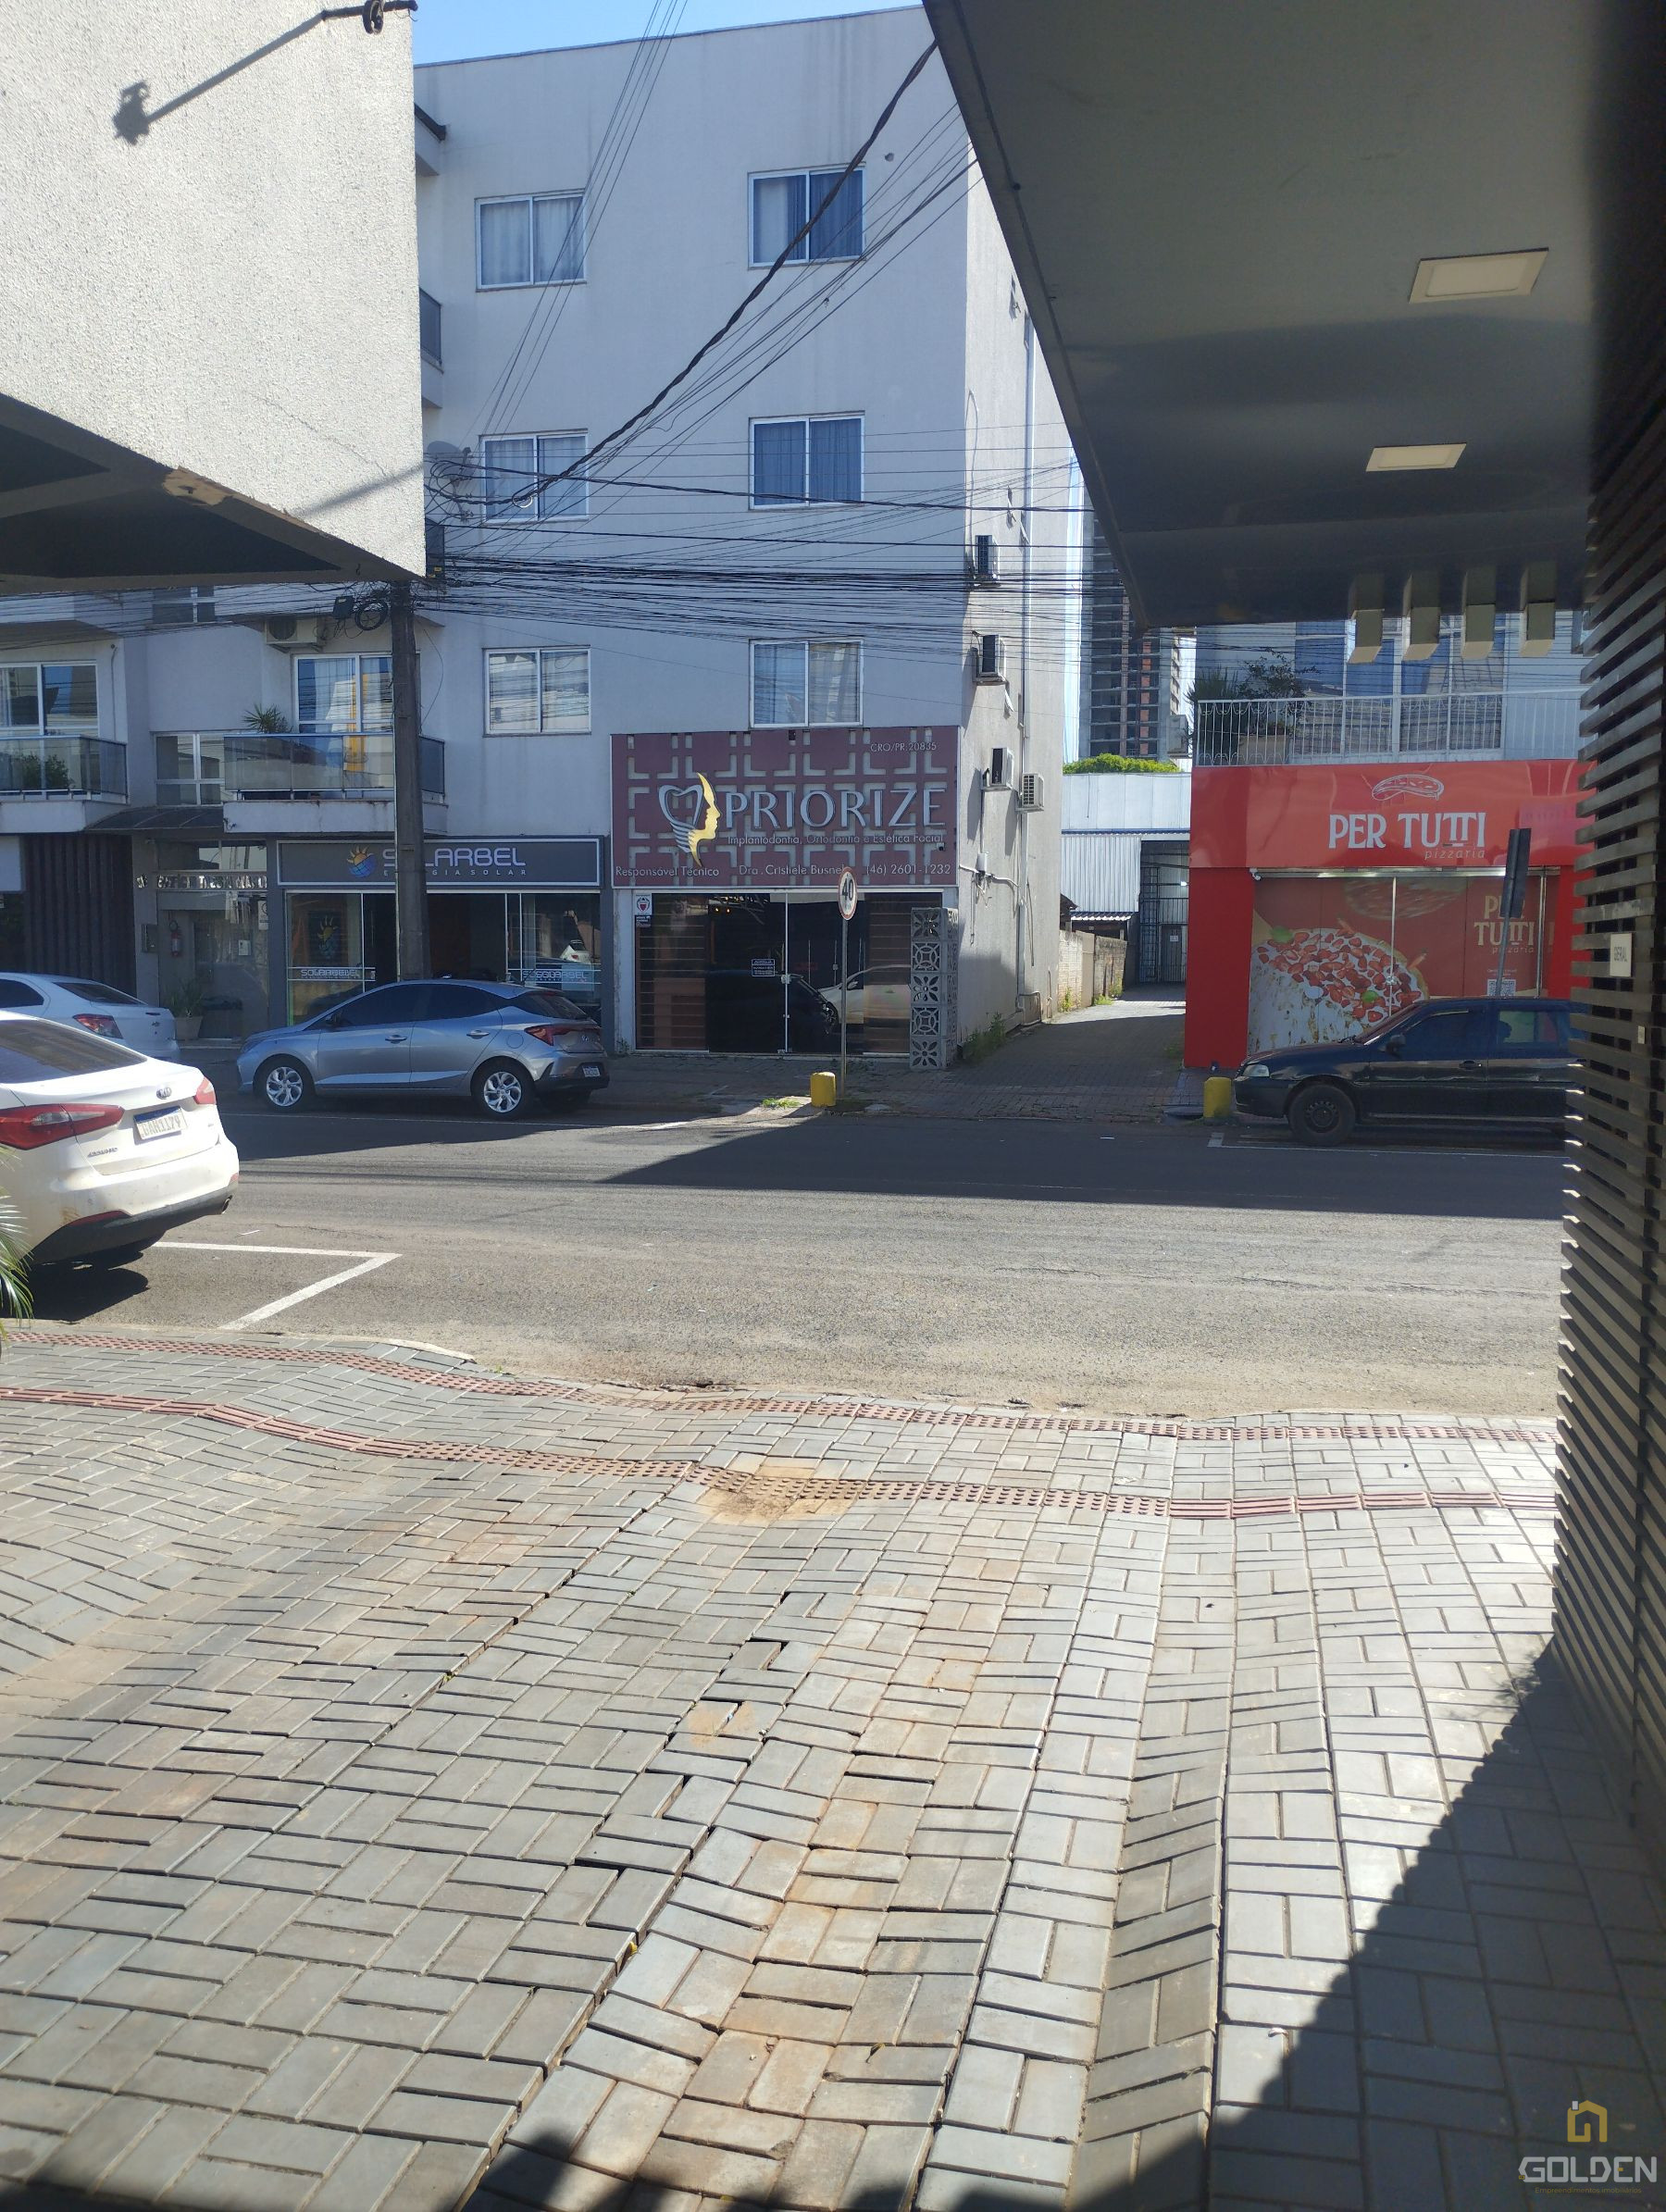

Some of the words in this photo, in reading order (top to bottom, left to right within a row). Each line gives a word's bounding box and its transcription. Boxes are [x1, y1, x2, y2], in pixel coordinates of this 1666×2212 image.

[726, 789, 946, 829] PRIORIZE
[1328, 814, 1387, 849] PER
[1397, 812, 1487, 849] TUTTI
[382, 847, 527, 867] SARBEL
[1424, 846, 1485, 861] pizzaria
[615, 865, 678, 877] Responsável
[680, 865, 719, 876] Técnico
[866, 864, 887, 876] (46)
[841, 877, 853, 901] 40
